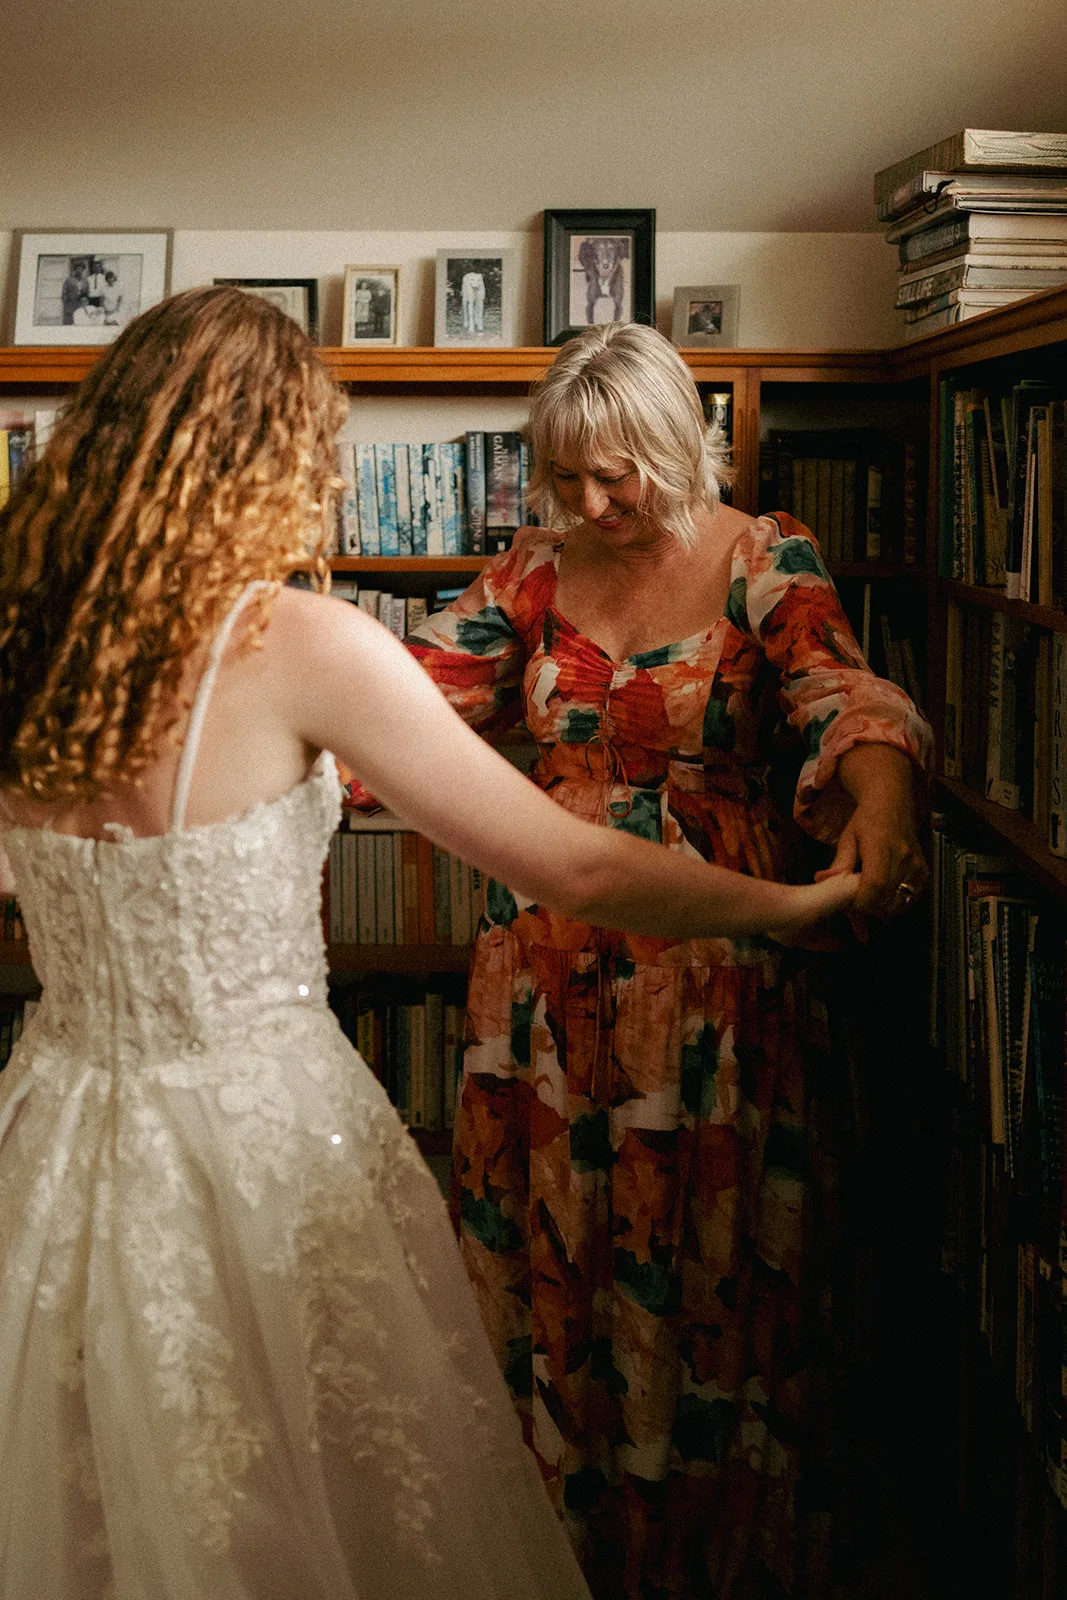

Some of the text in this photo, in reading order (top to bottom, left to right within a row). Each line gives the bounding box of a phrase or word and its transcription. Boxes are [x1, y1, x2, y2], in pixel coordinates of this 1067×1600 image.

[916, 277, 935, 300] LIFE
[493, 435, 504, 481] GAIMAN
[1053, 643, 1063, 806] PARIS
